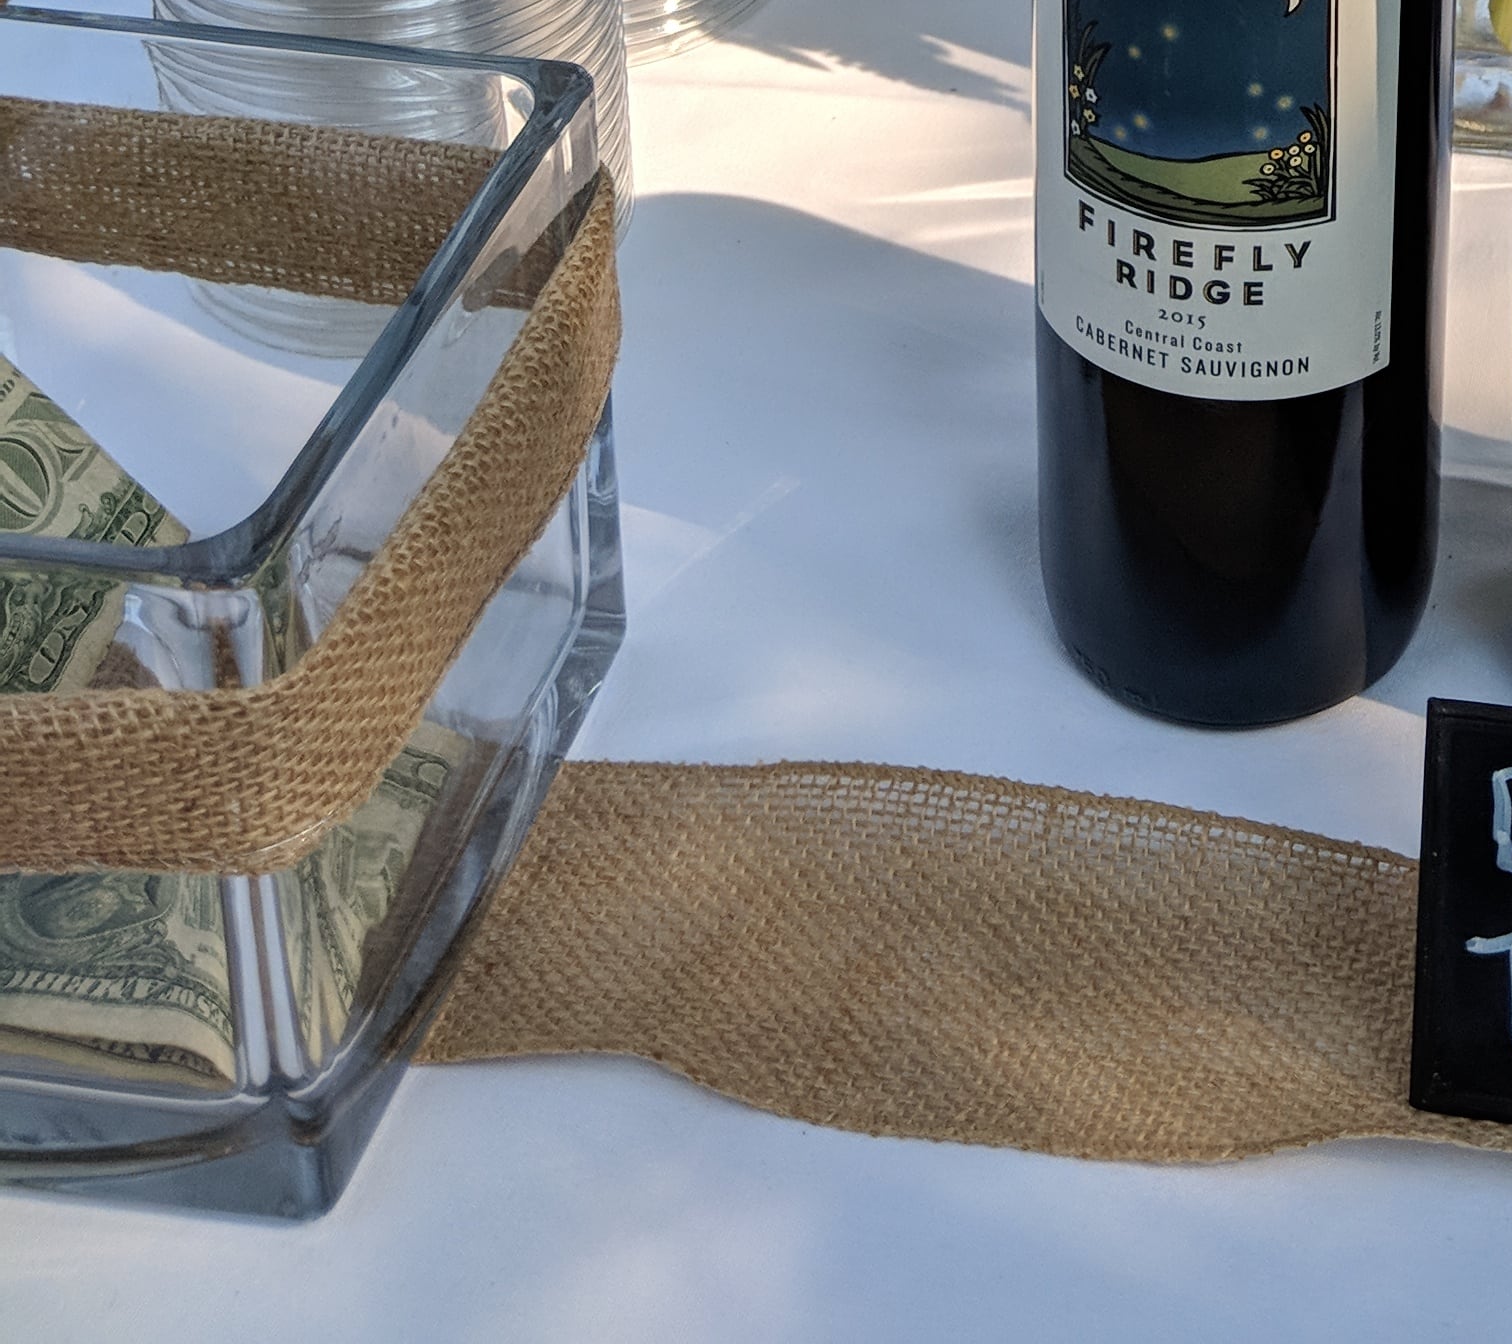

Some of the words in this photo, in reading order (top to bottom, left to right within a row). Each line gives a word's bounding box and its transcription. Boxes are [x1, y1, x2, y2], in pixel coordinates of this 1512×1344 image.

[1077, 198, 1312, 272] FIREFLY
[1115, 257, 1265, 307] RIDGE
[1124, 318, 1185, 349] Central
[1192, 336, 1243, 354] Coast
[1157, 308, 1208, 330] 2015
[1075, 315, 1170, 370] CABERNET
[1180, 355, 1311, 379] SAUVIGNON
